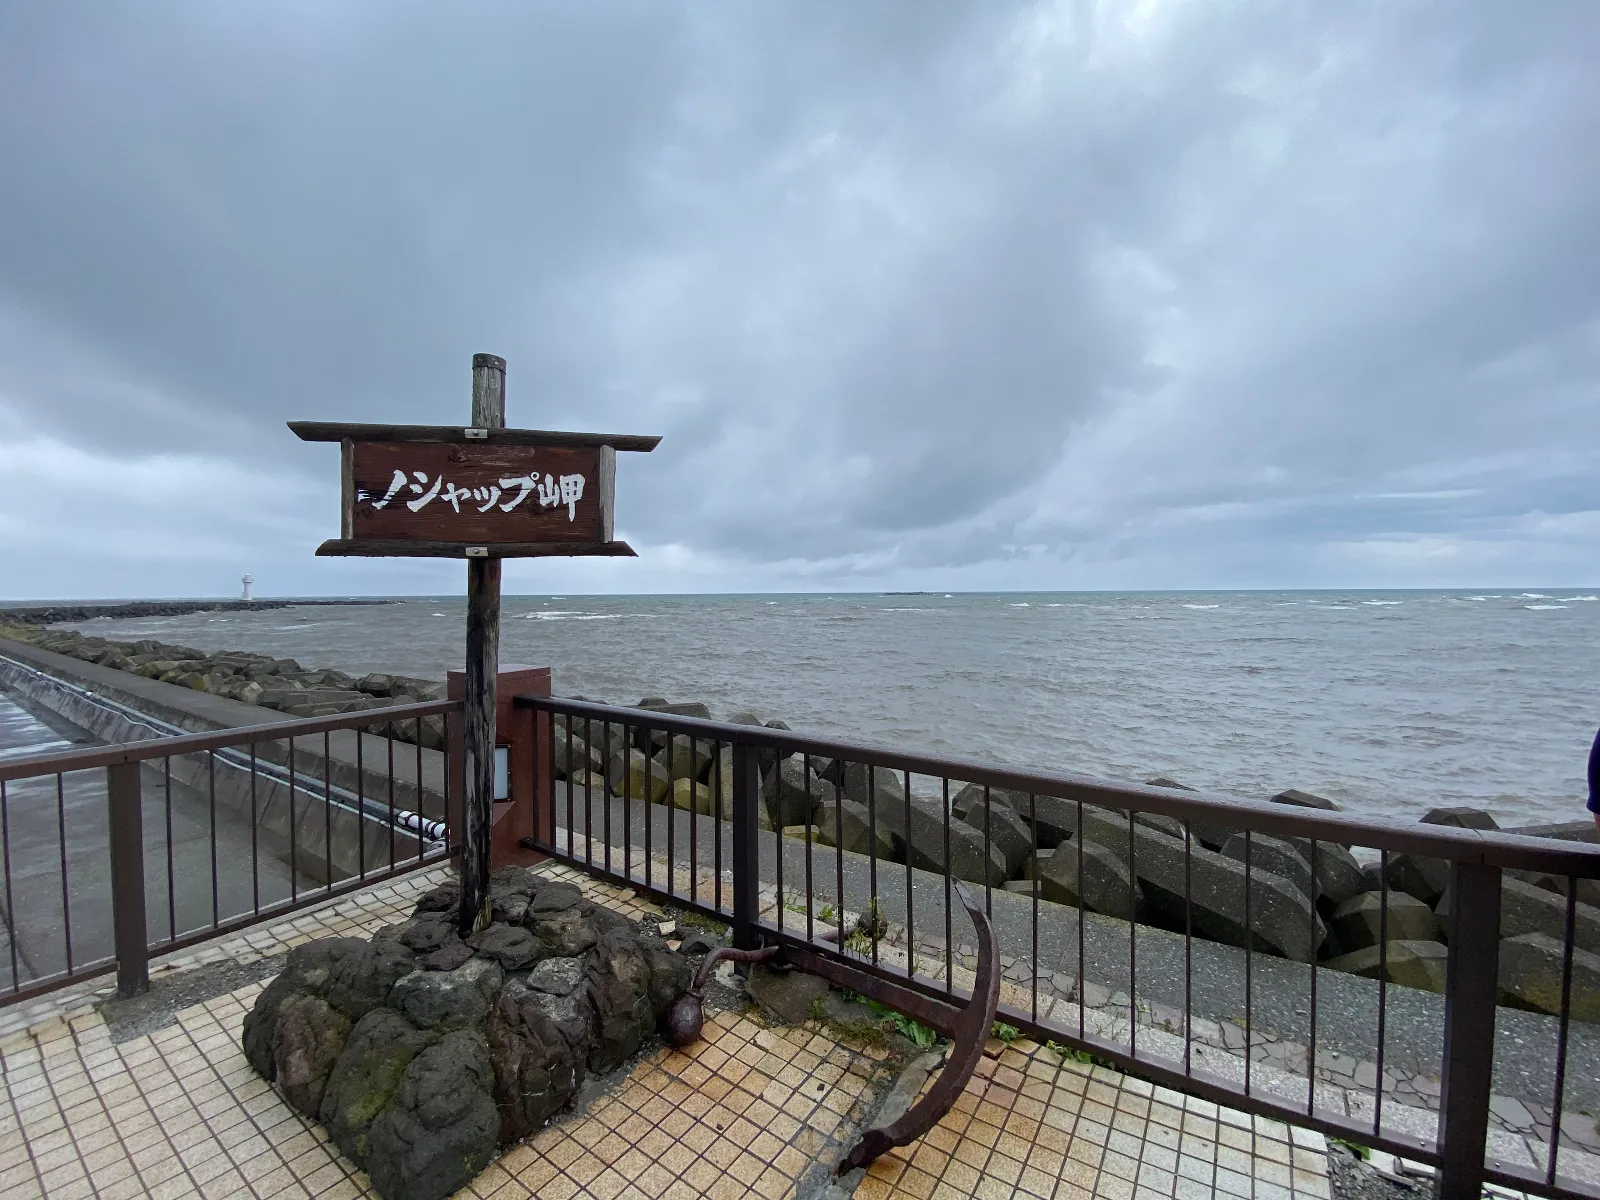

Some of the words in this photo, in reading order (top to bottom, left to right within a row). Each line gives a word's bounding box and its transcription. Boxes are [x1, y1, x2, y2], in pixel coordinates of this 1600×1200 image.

[371, 469, 586, 522] ノシャップ岬
